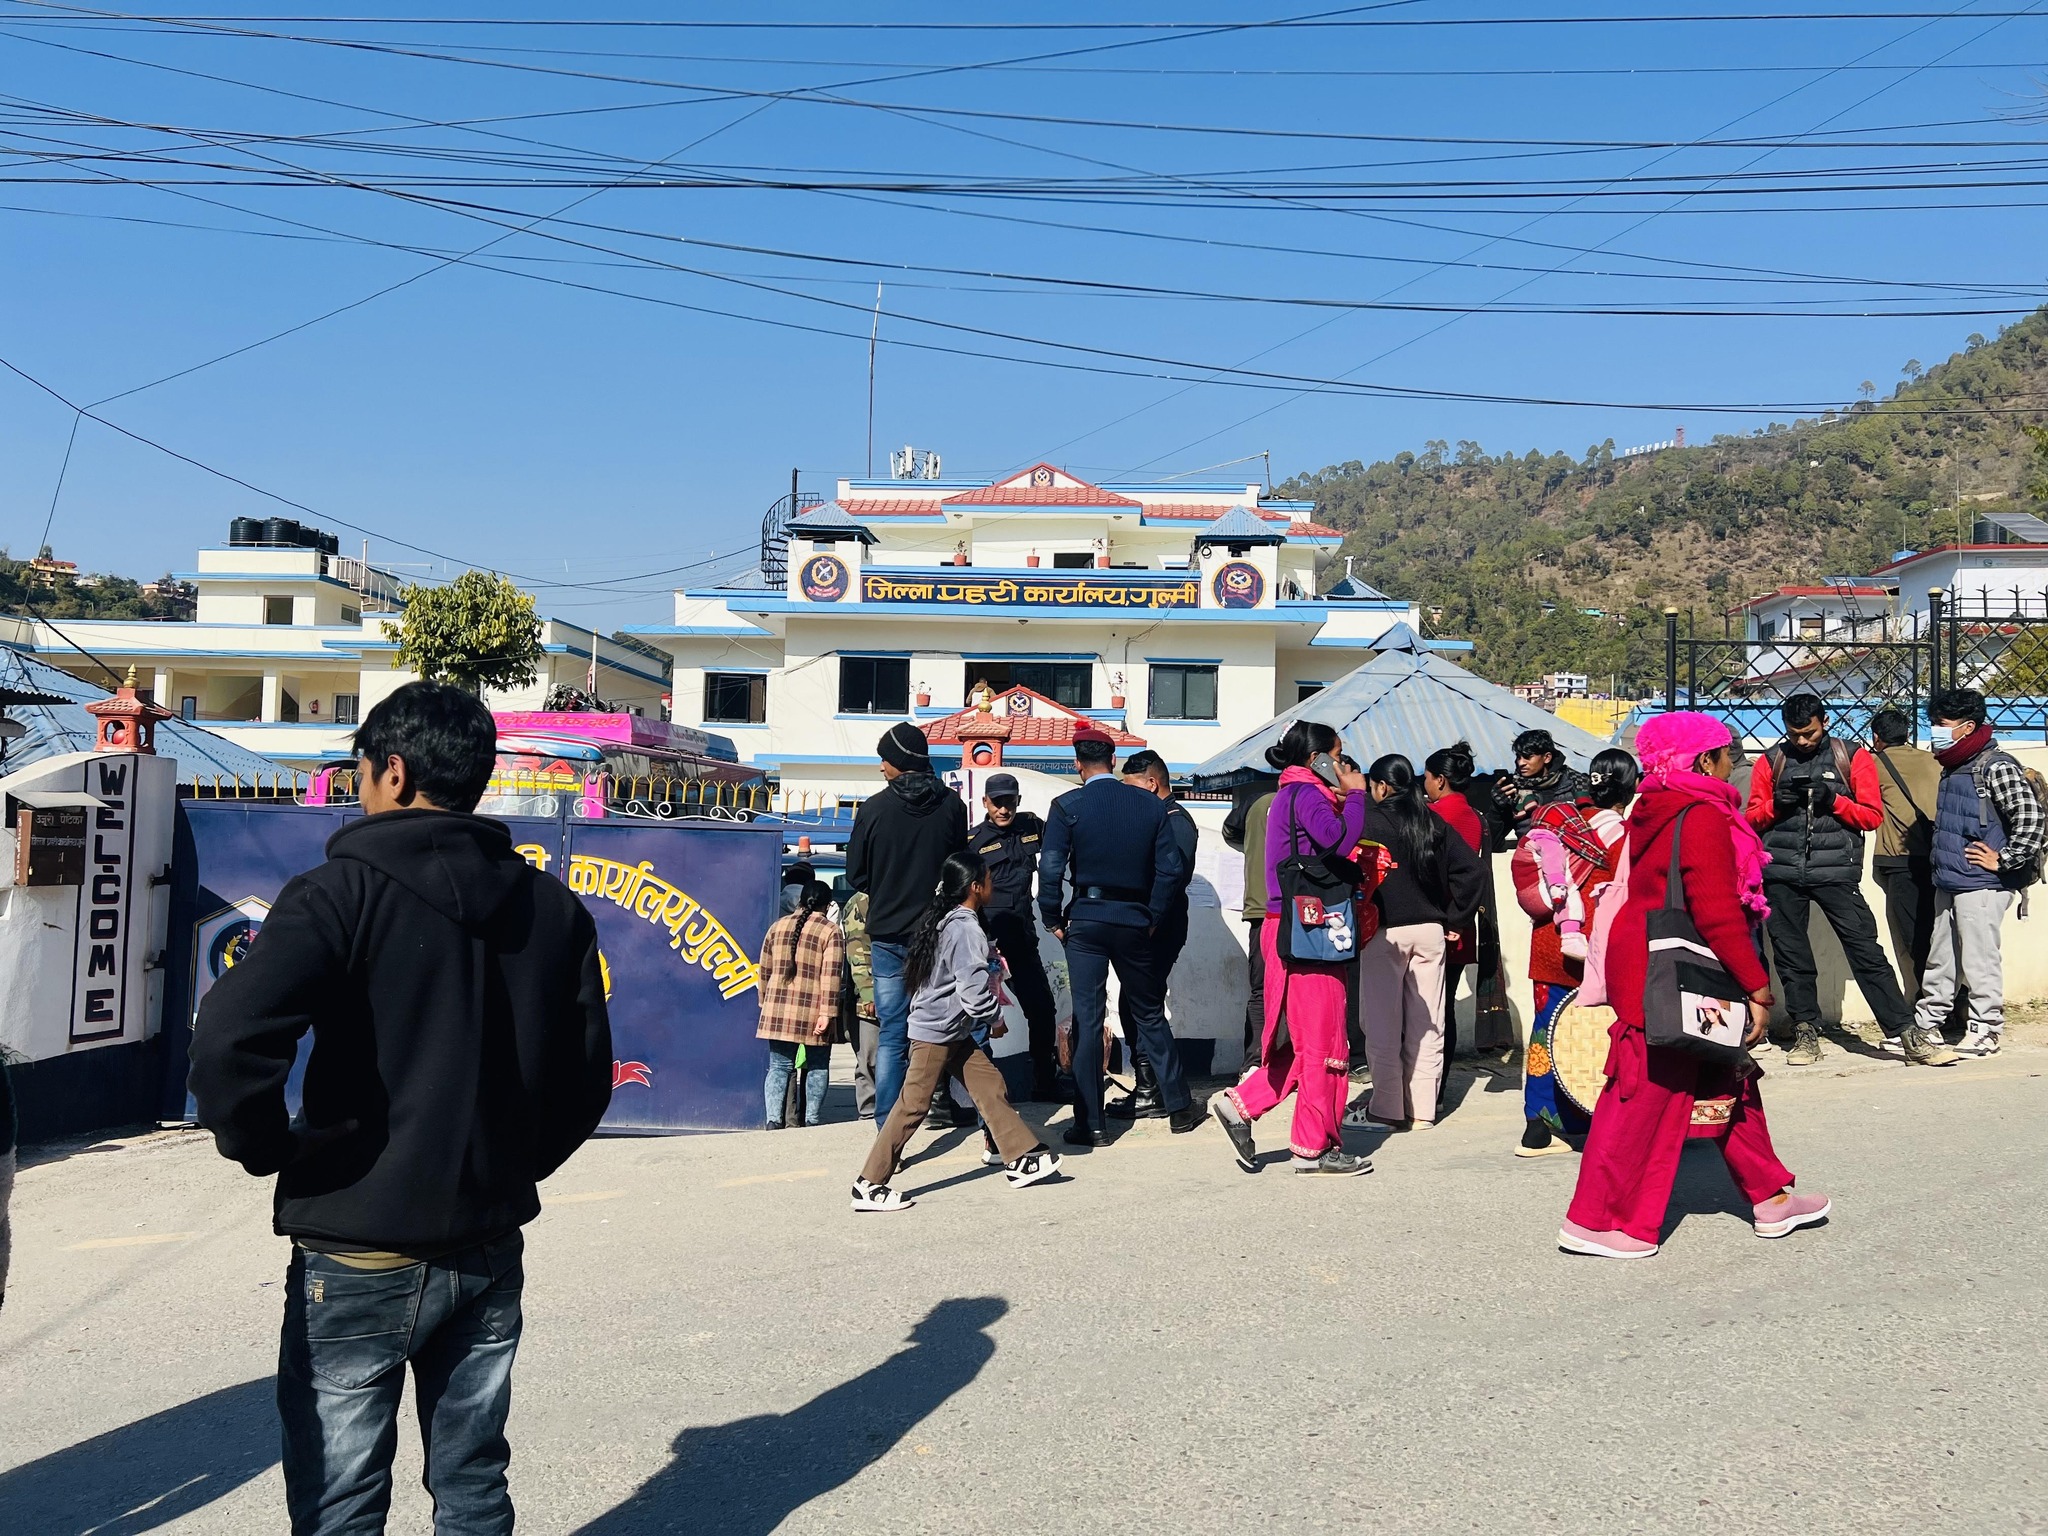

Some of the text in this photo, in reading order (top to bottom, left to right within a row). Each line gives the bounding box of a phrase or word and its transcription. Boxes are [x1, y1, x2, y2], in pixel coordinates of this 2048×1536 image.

[1625, 440, 1675, 456] RESUNGA
[865, 576, 935, 600] जिल्ला
[937, 580, 1020, 604] प्रहरी
